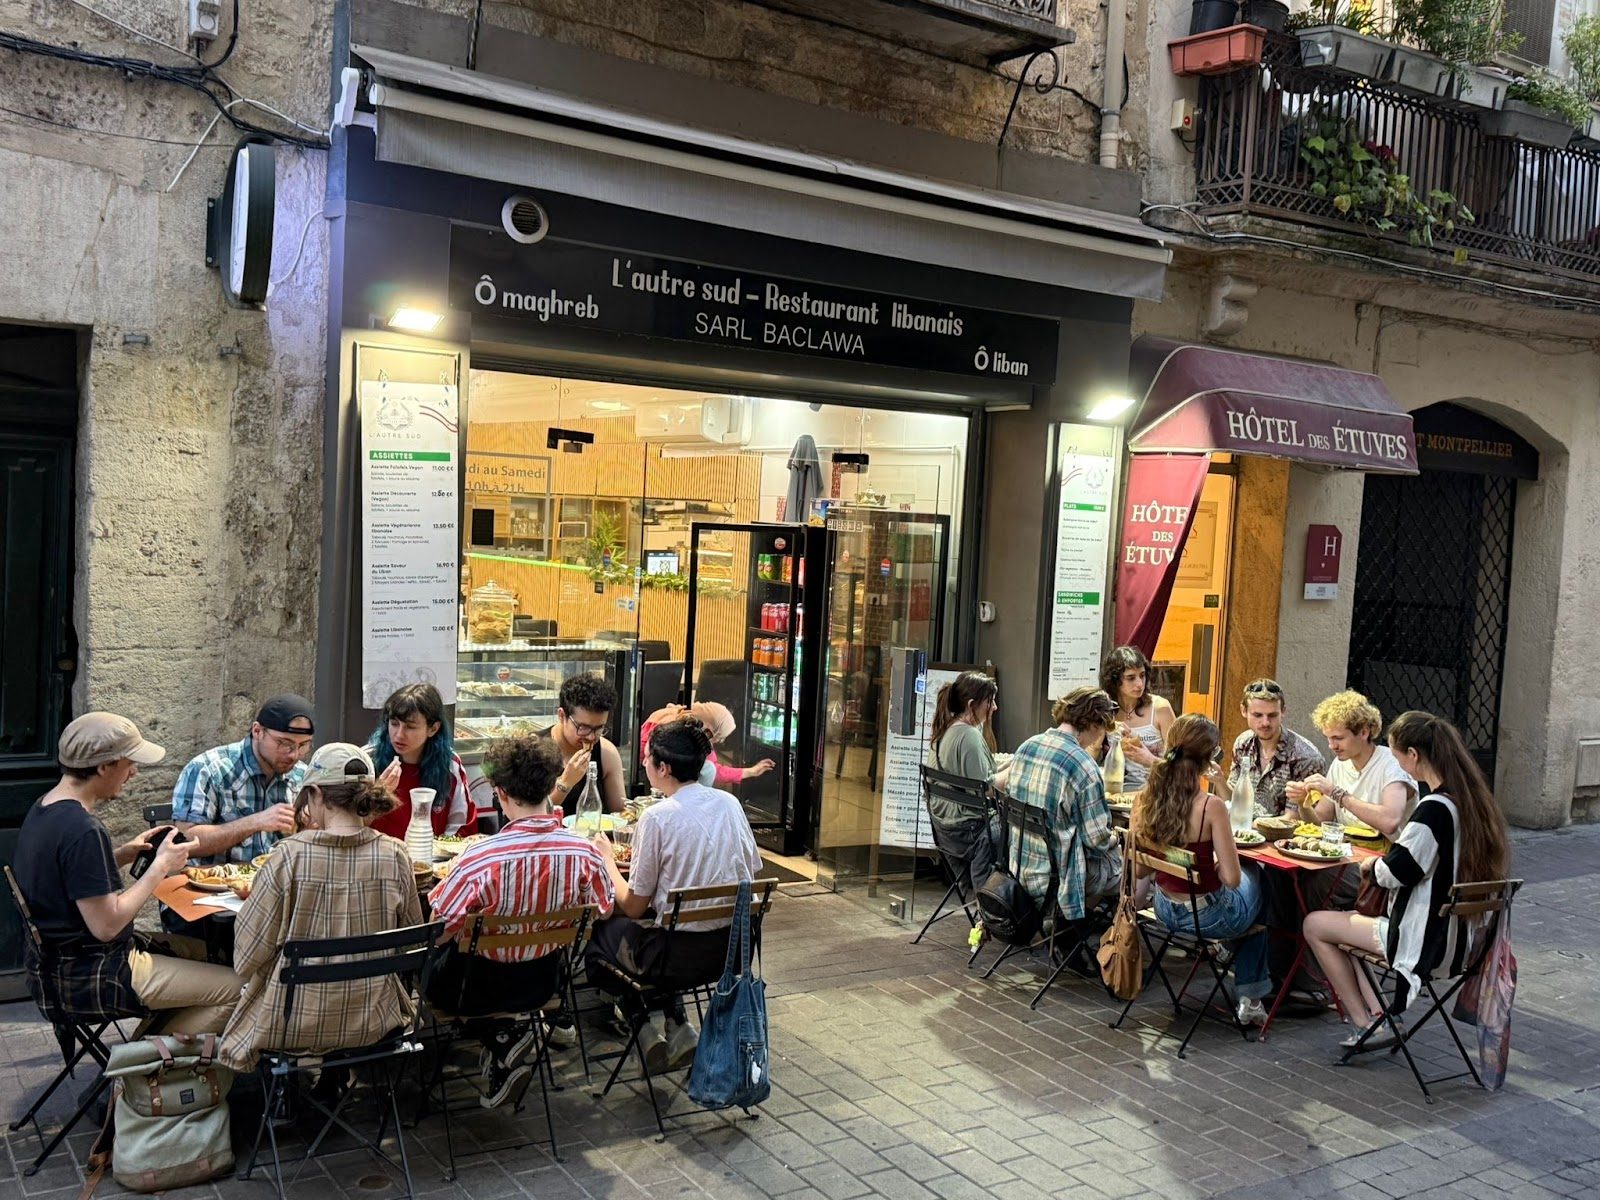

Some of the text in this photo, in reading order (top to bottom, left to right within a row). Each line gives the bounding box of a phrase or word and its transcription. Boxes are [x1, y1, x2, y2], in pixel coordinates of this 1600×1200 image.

[474, 274, 599, 322] Ô maghreb
[612, 258, 695, 298] L'autre
[702, 278, 741, 305] sud
[765, 283, 879, 325] Restaurant
[891, 302, 963, 337] libanais
[695, 312, 865, 356] SARL BACLAWA
[974, 345, 1029, 377] Ô liban
[1226, 407, 1408, 460] HÔTEL DES ÉTUVES
[1428, 432, 1514, 459] MONTPELLIER
[372, 452, 413, 460] ASSIETTES
[483, 466, 498, 475] au
[501, 466, 546, 478] Samedi
[1130, 500, 1189, 524] HÔTE
[1152, 531, 1174, 542] DES
[1323, 535, 1338, 557] H
[1124, 541, 1175, 565] ÉTUV
